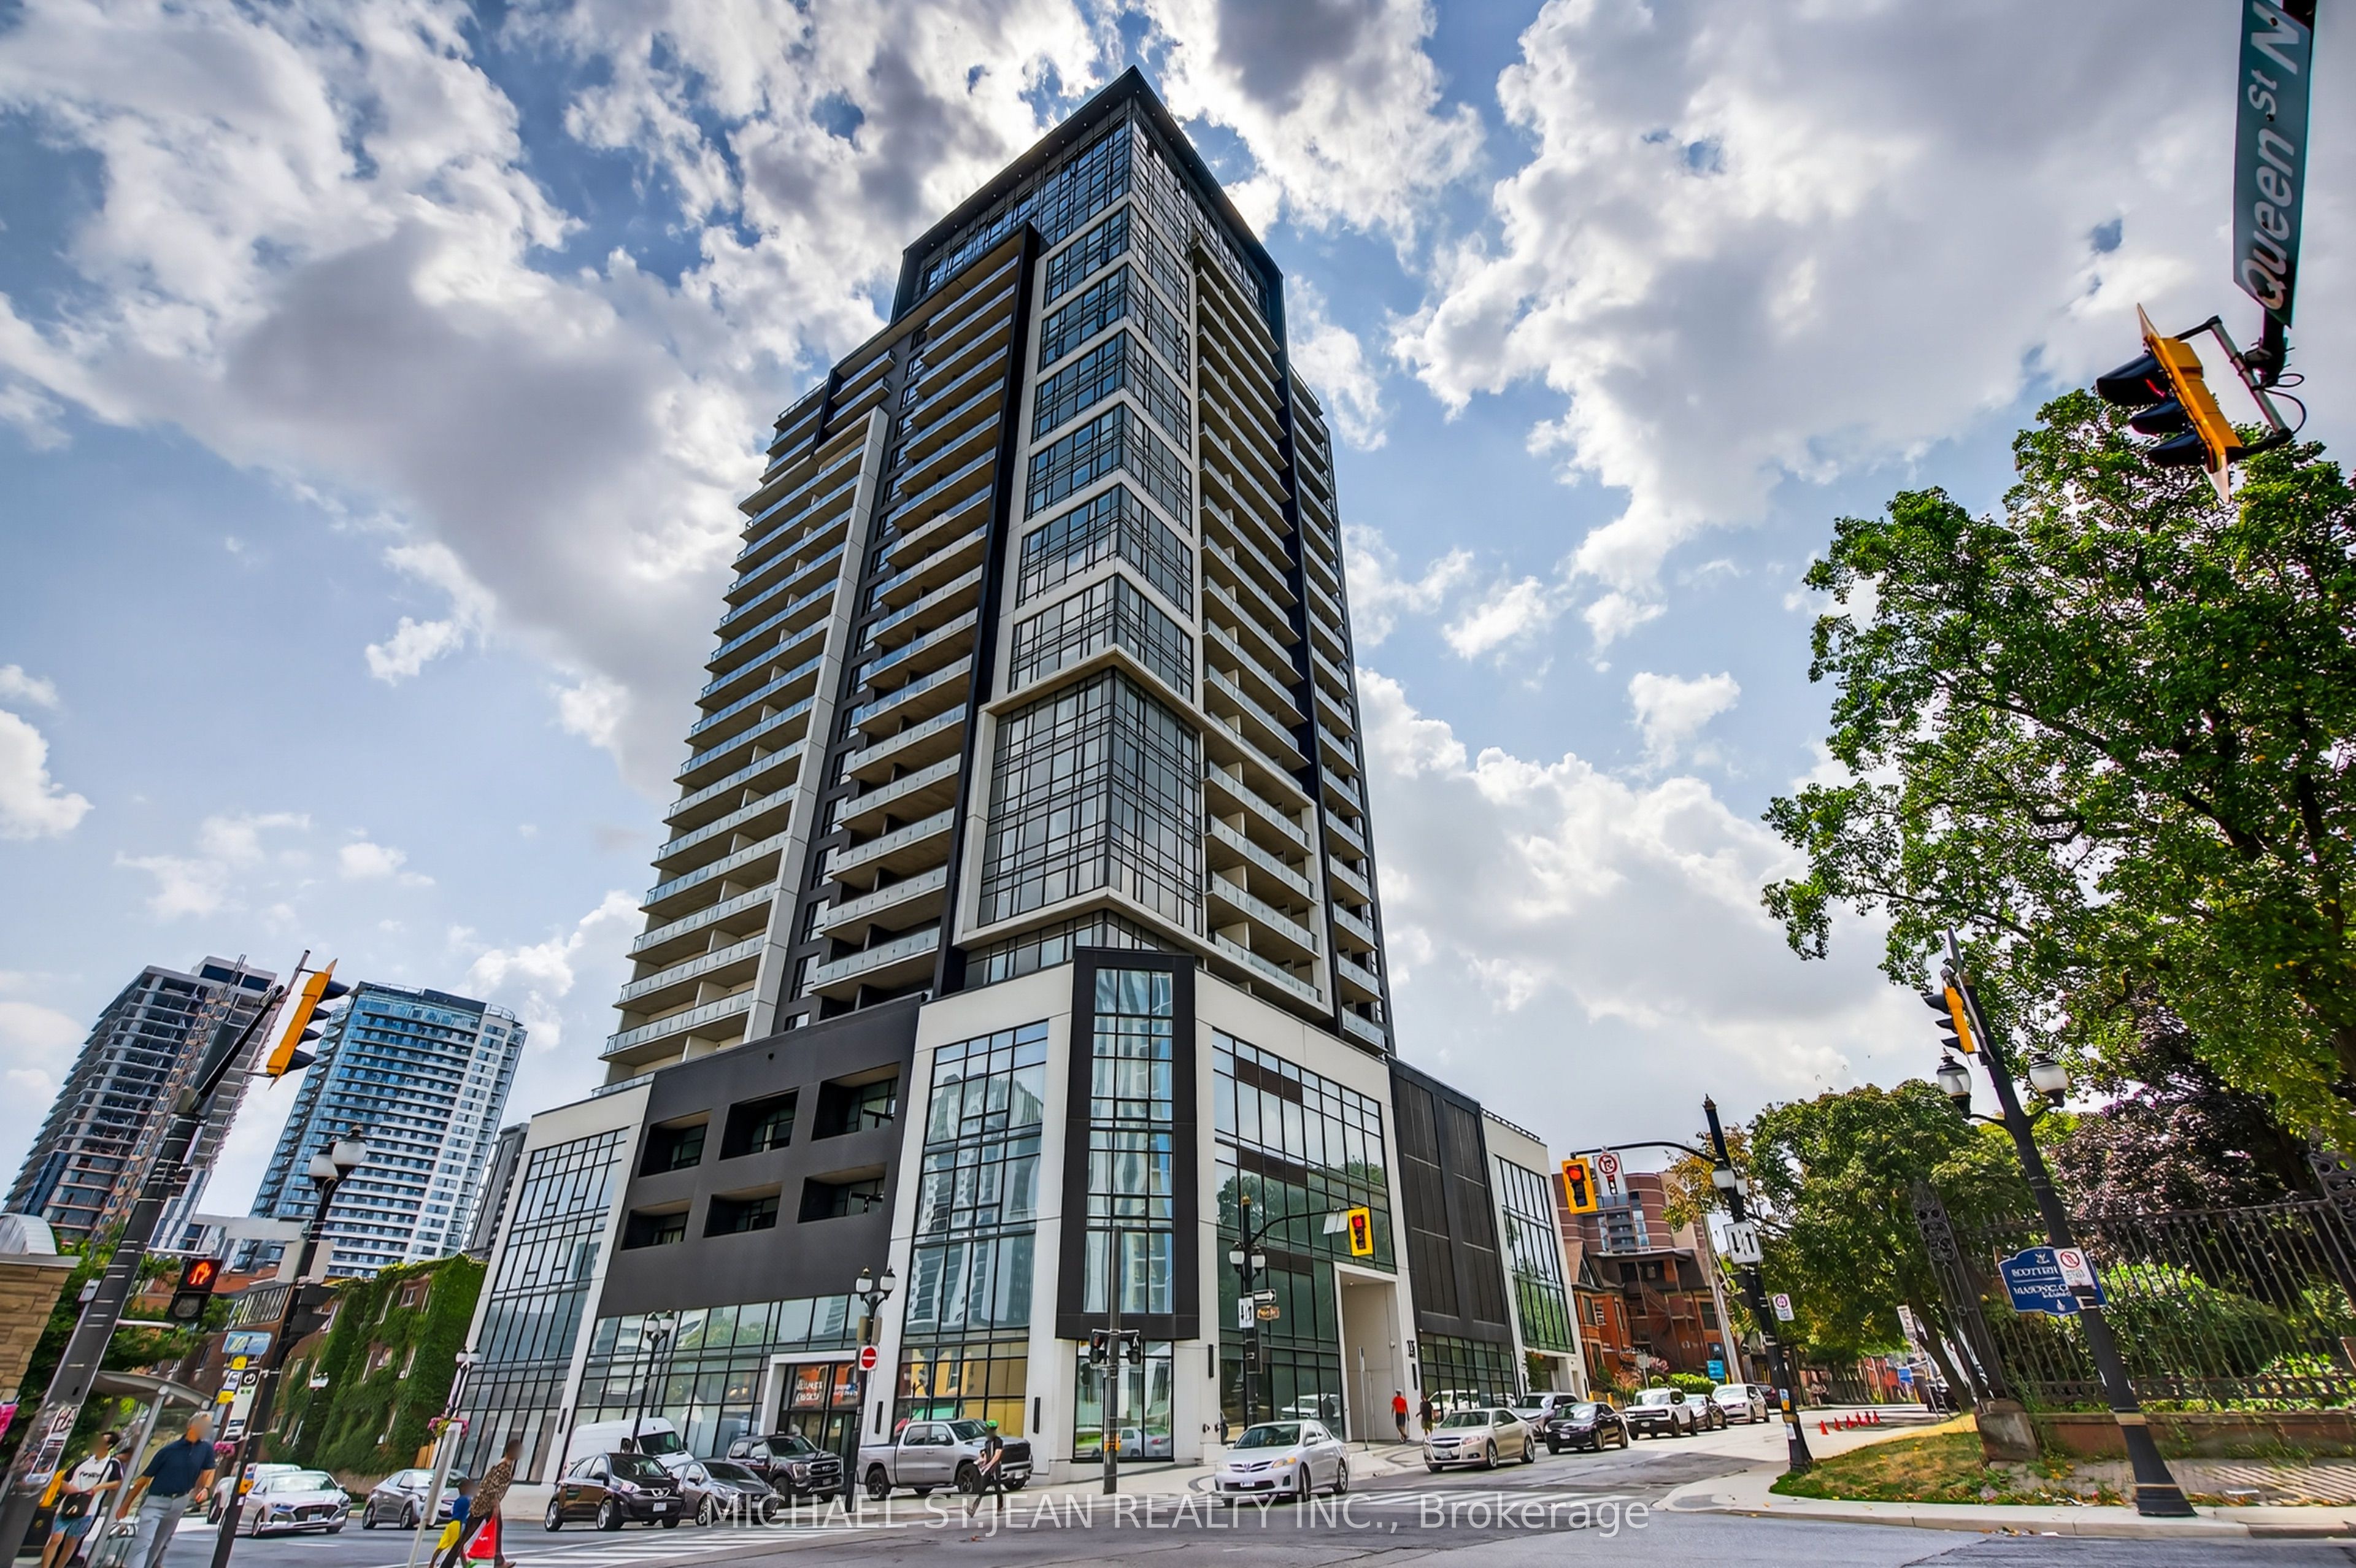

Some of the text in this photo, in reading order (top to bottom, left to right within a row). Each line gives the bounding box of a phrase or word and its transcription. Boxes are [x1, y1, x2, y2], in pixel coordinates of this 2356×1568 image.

[2241, 1, 2299, 310] Queen St N
